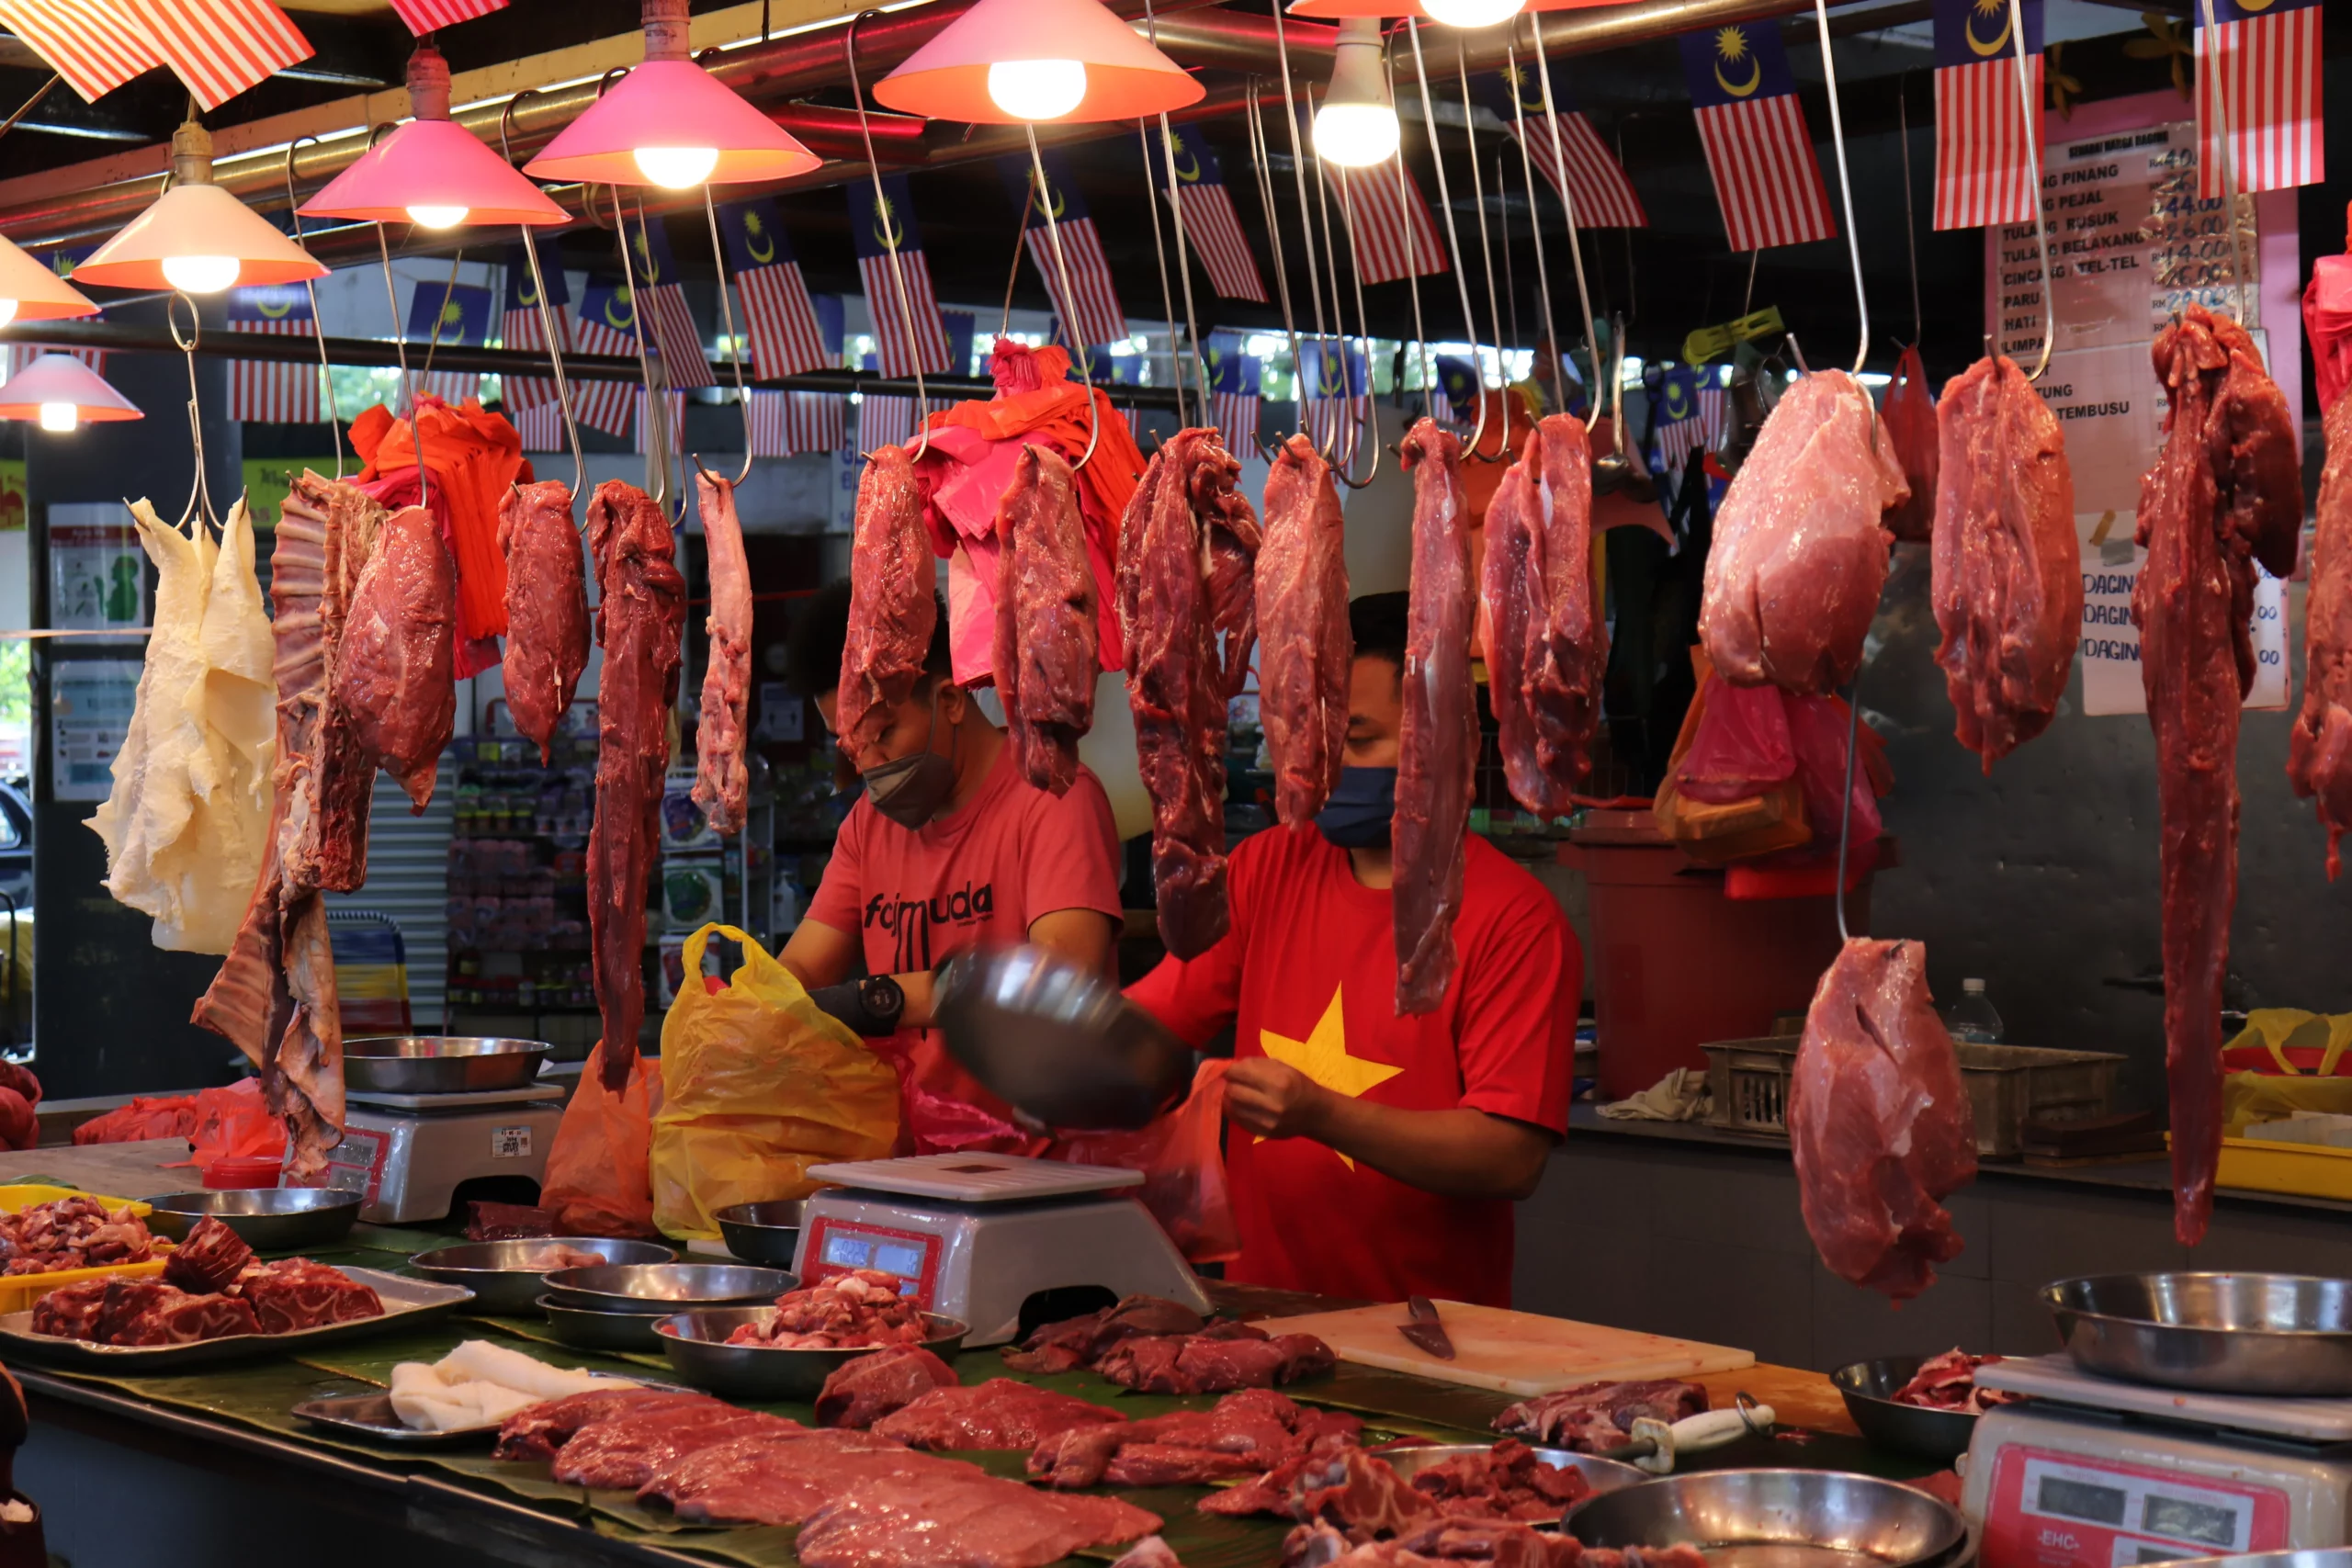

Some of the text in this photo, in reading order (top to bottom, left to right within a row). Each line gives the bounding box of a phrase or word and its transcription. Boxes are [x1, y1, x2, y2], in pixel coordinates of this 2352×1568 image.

[2063, 164, 2118, 185] PINANG
[2060, 190, 2103, 209] PEJAL
[2066, 211, 2118, 231] RUSUK
[2063, 232, 2144, 254] BELAKANG
[2076, 255, 2139, 274] TEL-TEL
[2004, 292, 2040, 308] PARU
[2003, 315, 2037, 331] HATI
[2004, 337, 2045, 353] LIMPA
[2056, 400, 2130, 421] TEMBUSU
[2082, 573, 2135, 594] DAGIN
[2083, 603, 2133, 625] DAGIN
[2084, 637, 2141, 660] DAGIN
